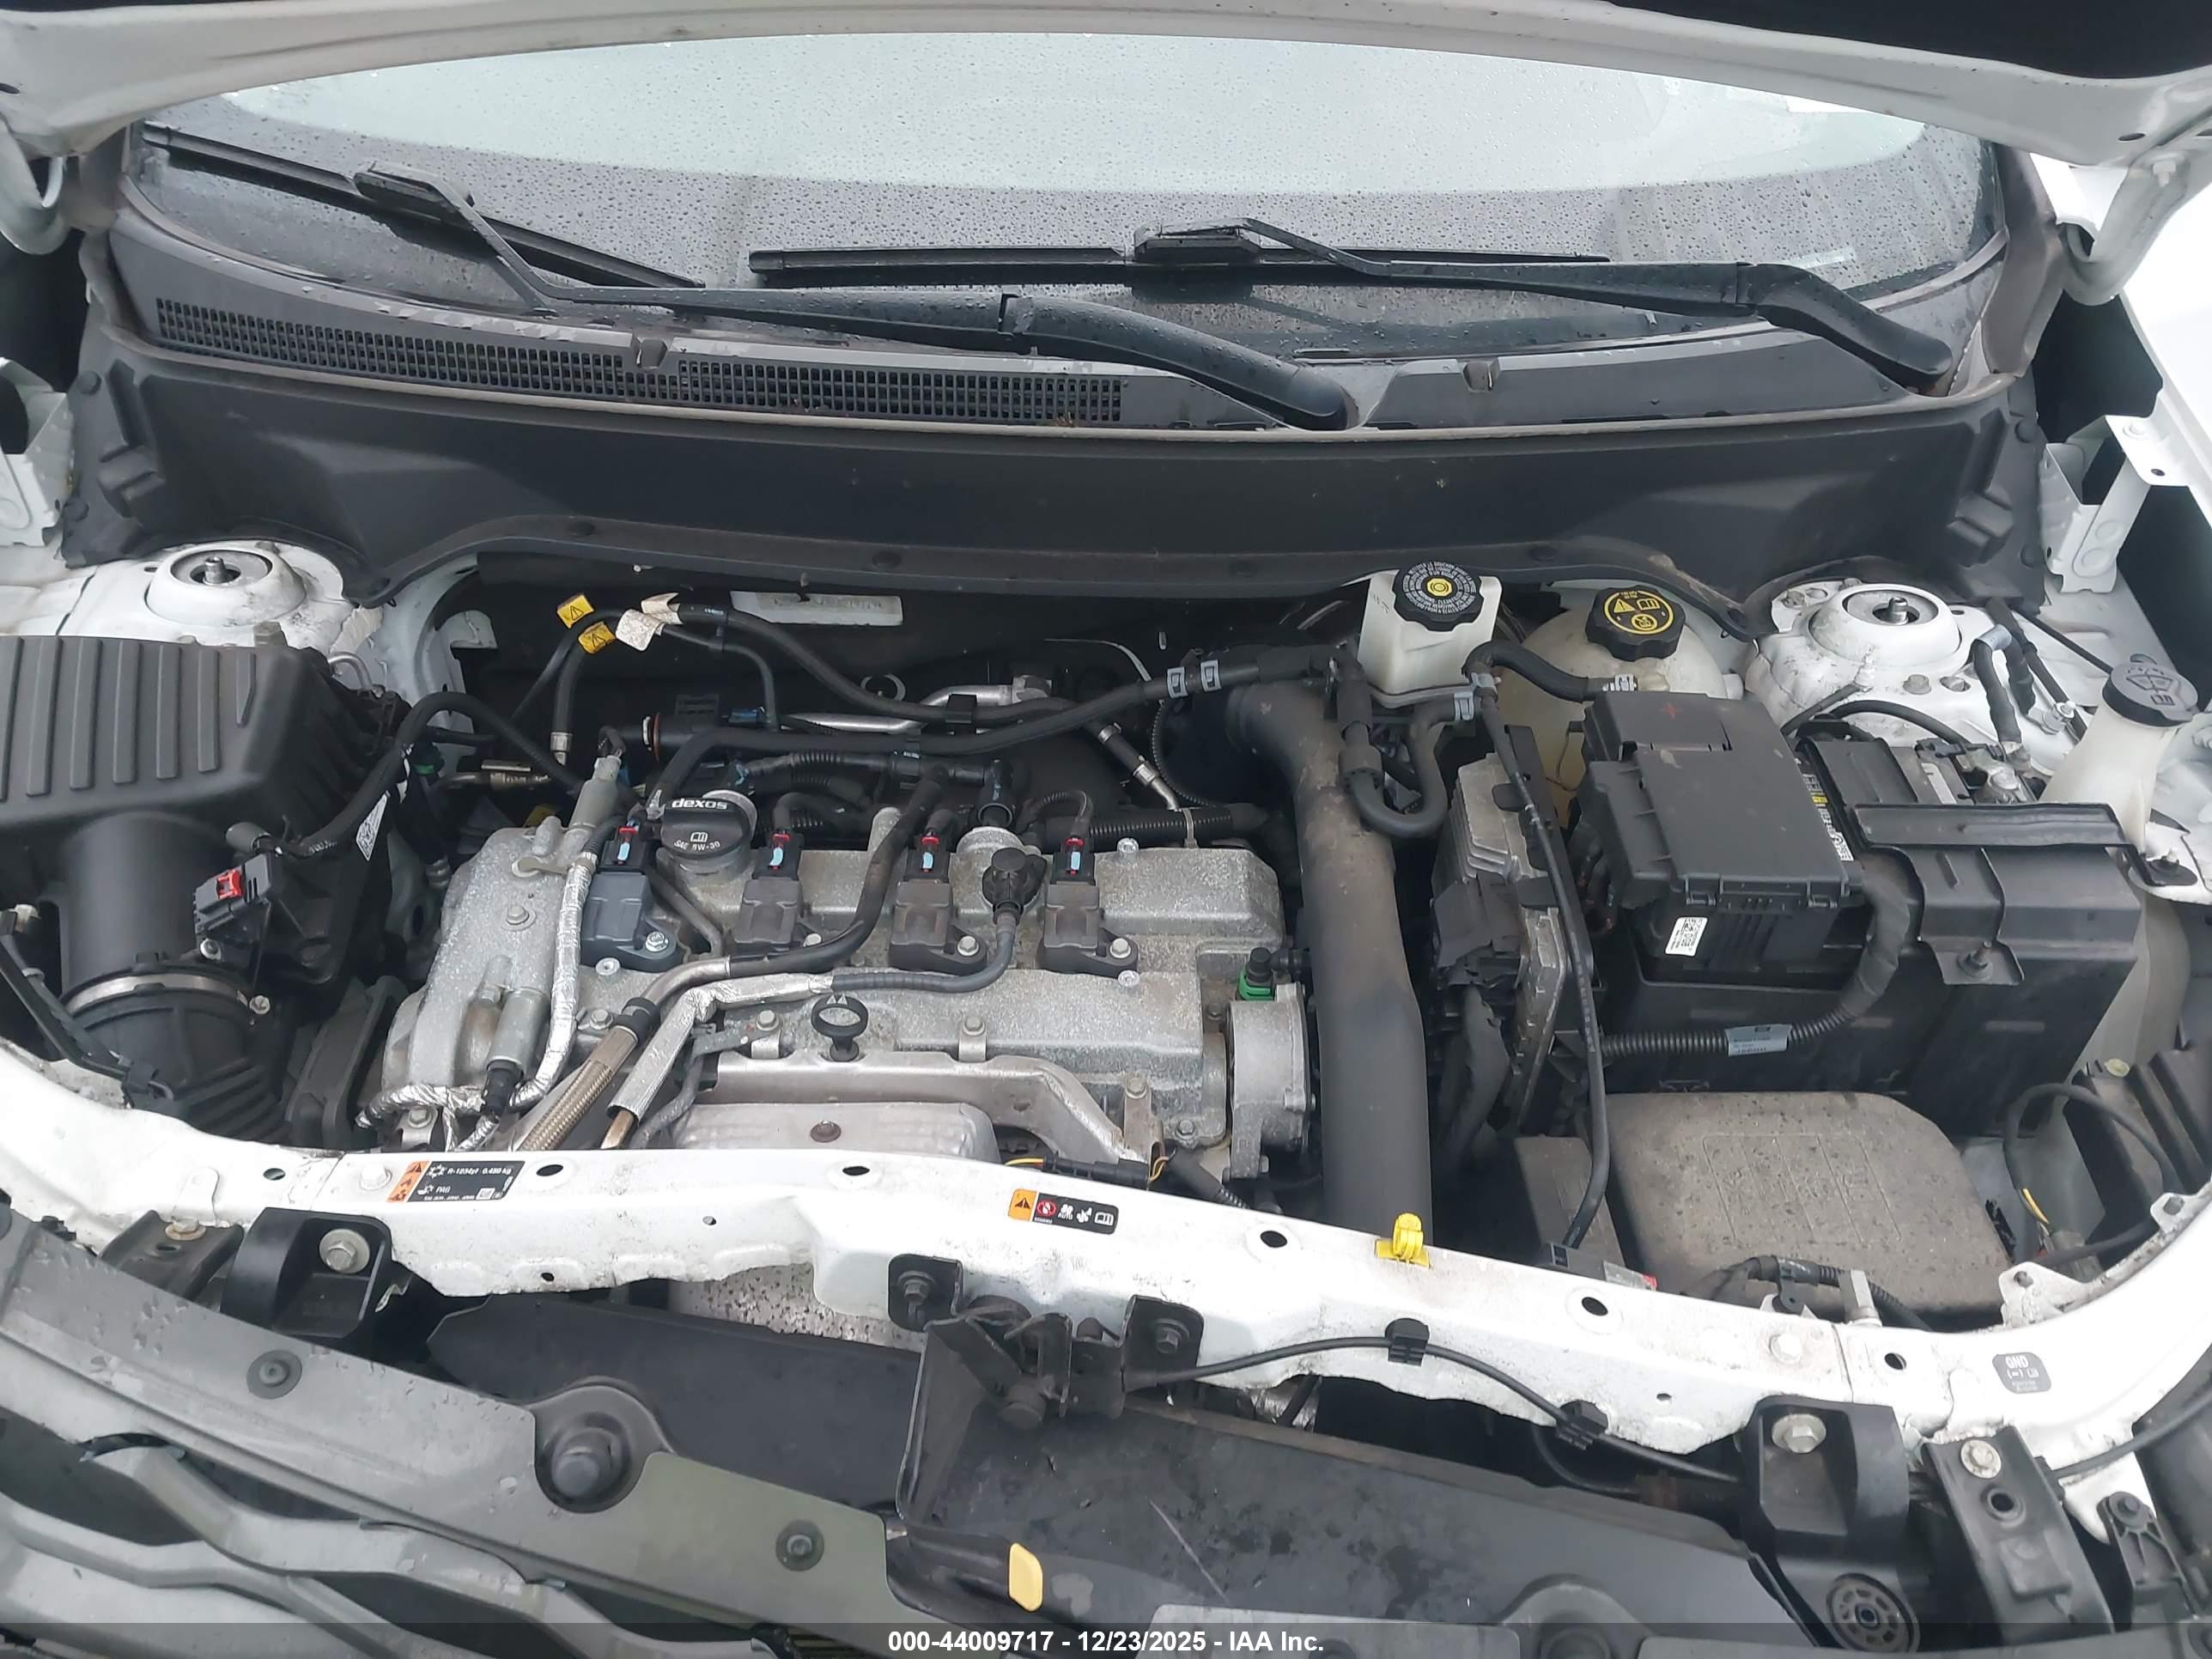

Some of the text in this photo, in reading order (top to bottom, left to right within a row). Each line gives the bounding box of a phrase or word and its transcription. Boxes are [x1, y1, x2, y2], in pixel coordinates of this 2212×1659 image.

[672, 798, 728, 810] dexos
[673, 839, 721, 851] SAE 5W-30
[2005, 1355, 2029, 1369] GND
